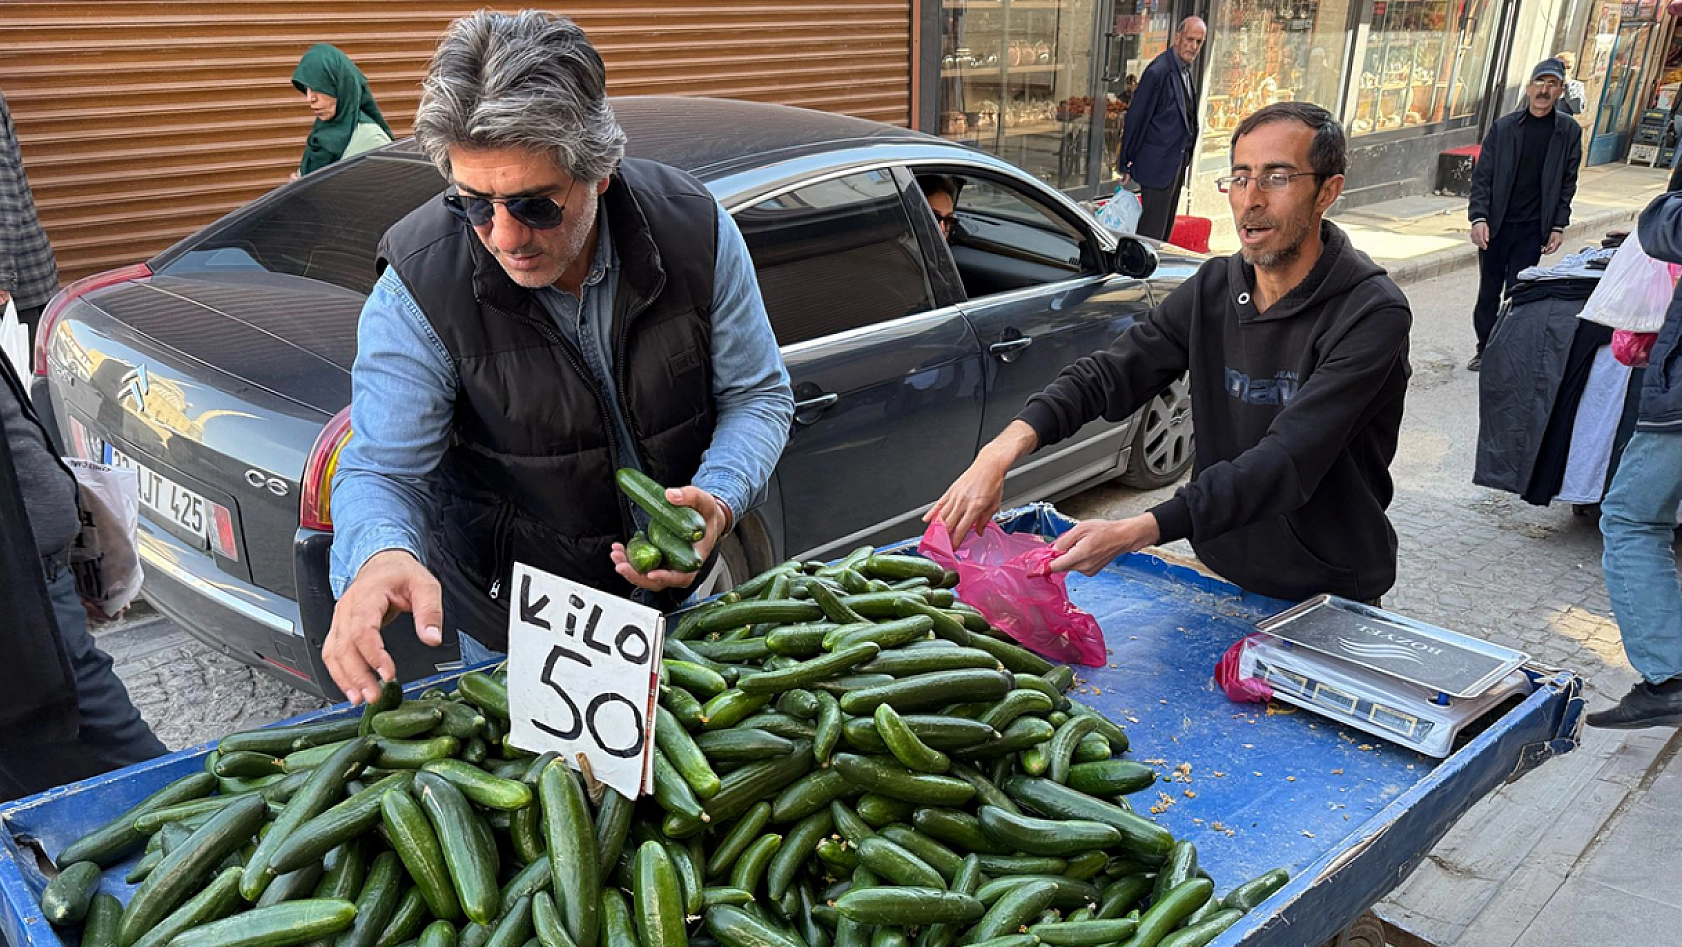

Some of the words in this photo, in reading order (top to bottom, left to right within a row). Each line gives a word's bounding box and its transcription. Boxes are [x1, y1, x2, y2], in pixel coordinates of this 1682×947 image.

[244, 468, 290, 497] C6
[170, 485, 203, 532] 425
[530, 644, 645, 759] 50
